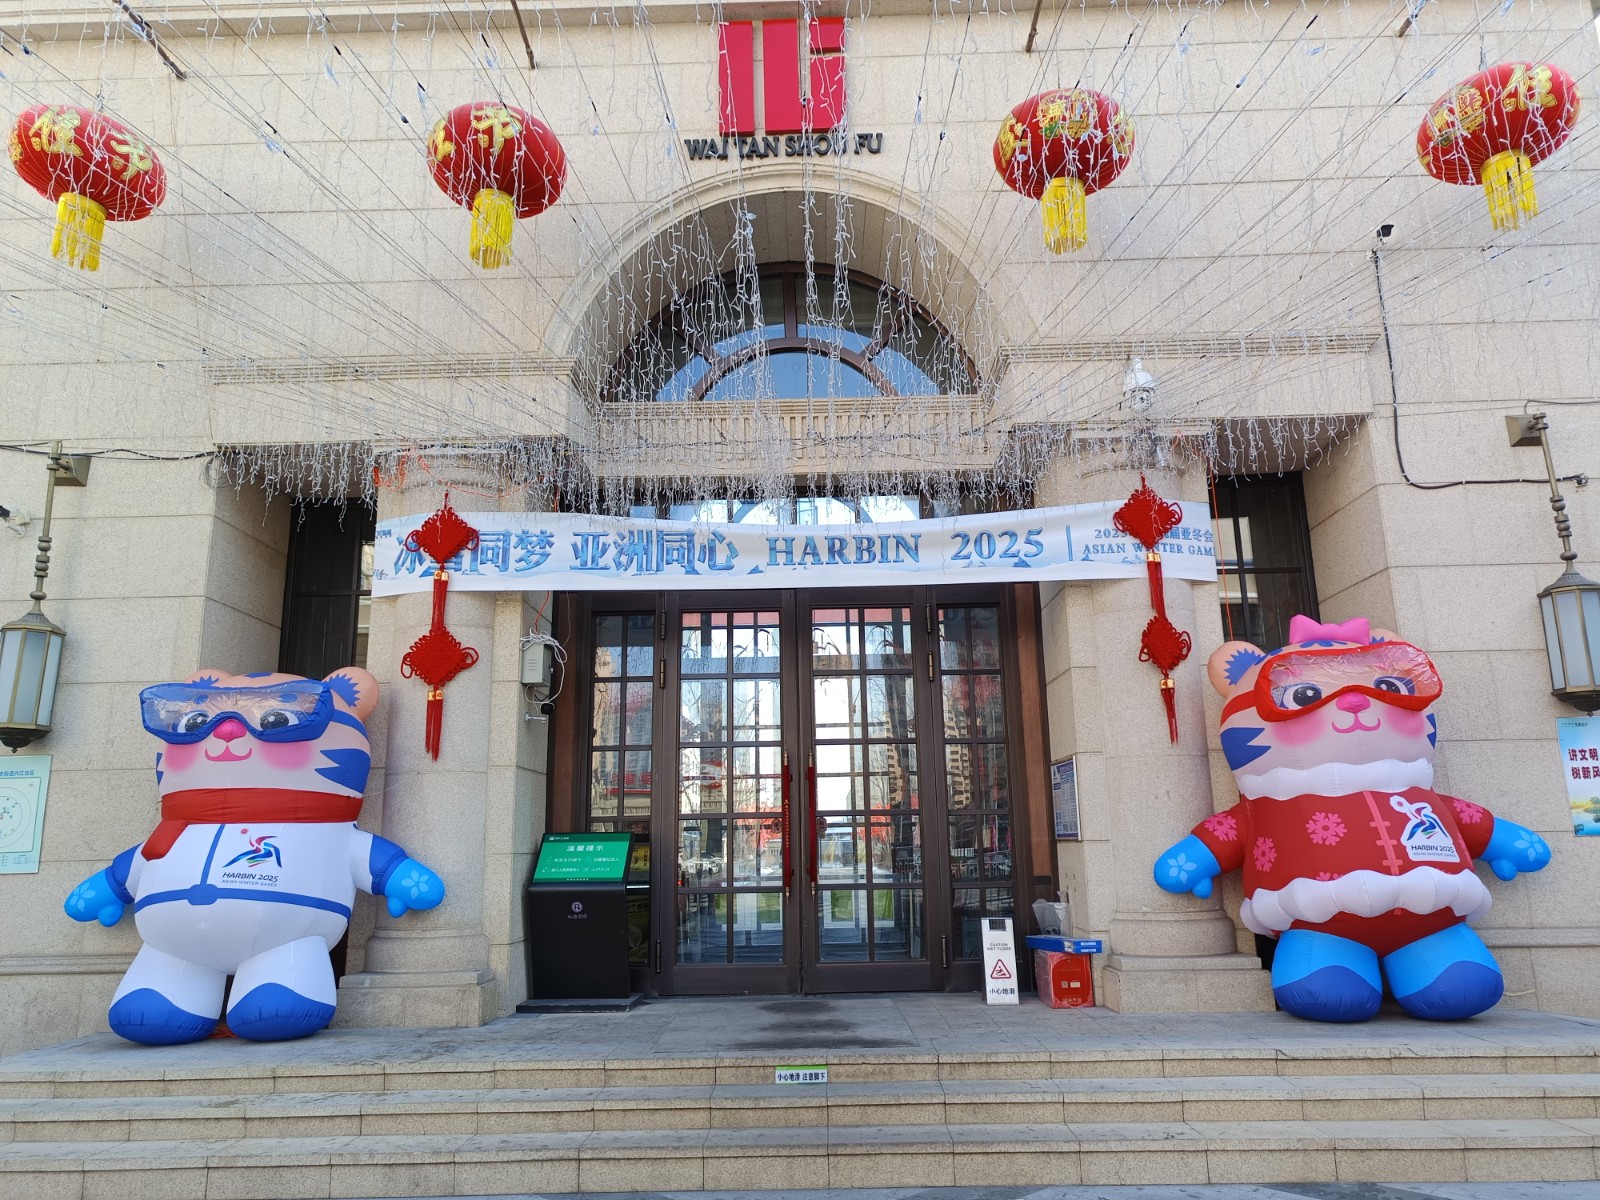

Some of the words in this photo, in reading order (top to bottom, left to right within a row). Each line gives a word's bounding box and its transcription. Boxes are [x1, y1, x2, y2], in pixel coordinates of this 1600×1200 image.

[684, 138, 728, 160] WAI
[734, 136, 779, 159] TAN
[784, 133, 848, 157] SHOU
[854, 132, 883, 155] FU
[570, 529, 742, 575] 亚洲同心
[766, 533, 922, 566] HARBIN
[950, 526, 1045, 561] 2025
[1083, 543, 1126, 555] ASIAN
[1132, 542, 1184, 554] WNTER
[1187, 544, 1215, 557] GAM
[1568, 748, 1599, 761] 讲文明
[1571, 766, 1600, 779] 树新风
[222, 872, 256, 880] HARBIN
[257, 874, 279, 882] 2025
[778, 1072, 800, 1081] 小心地滑
[802, 1072, 826, 1081] 注意脚下
